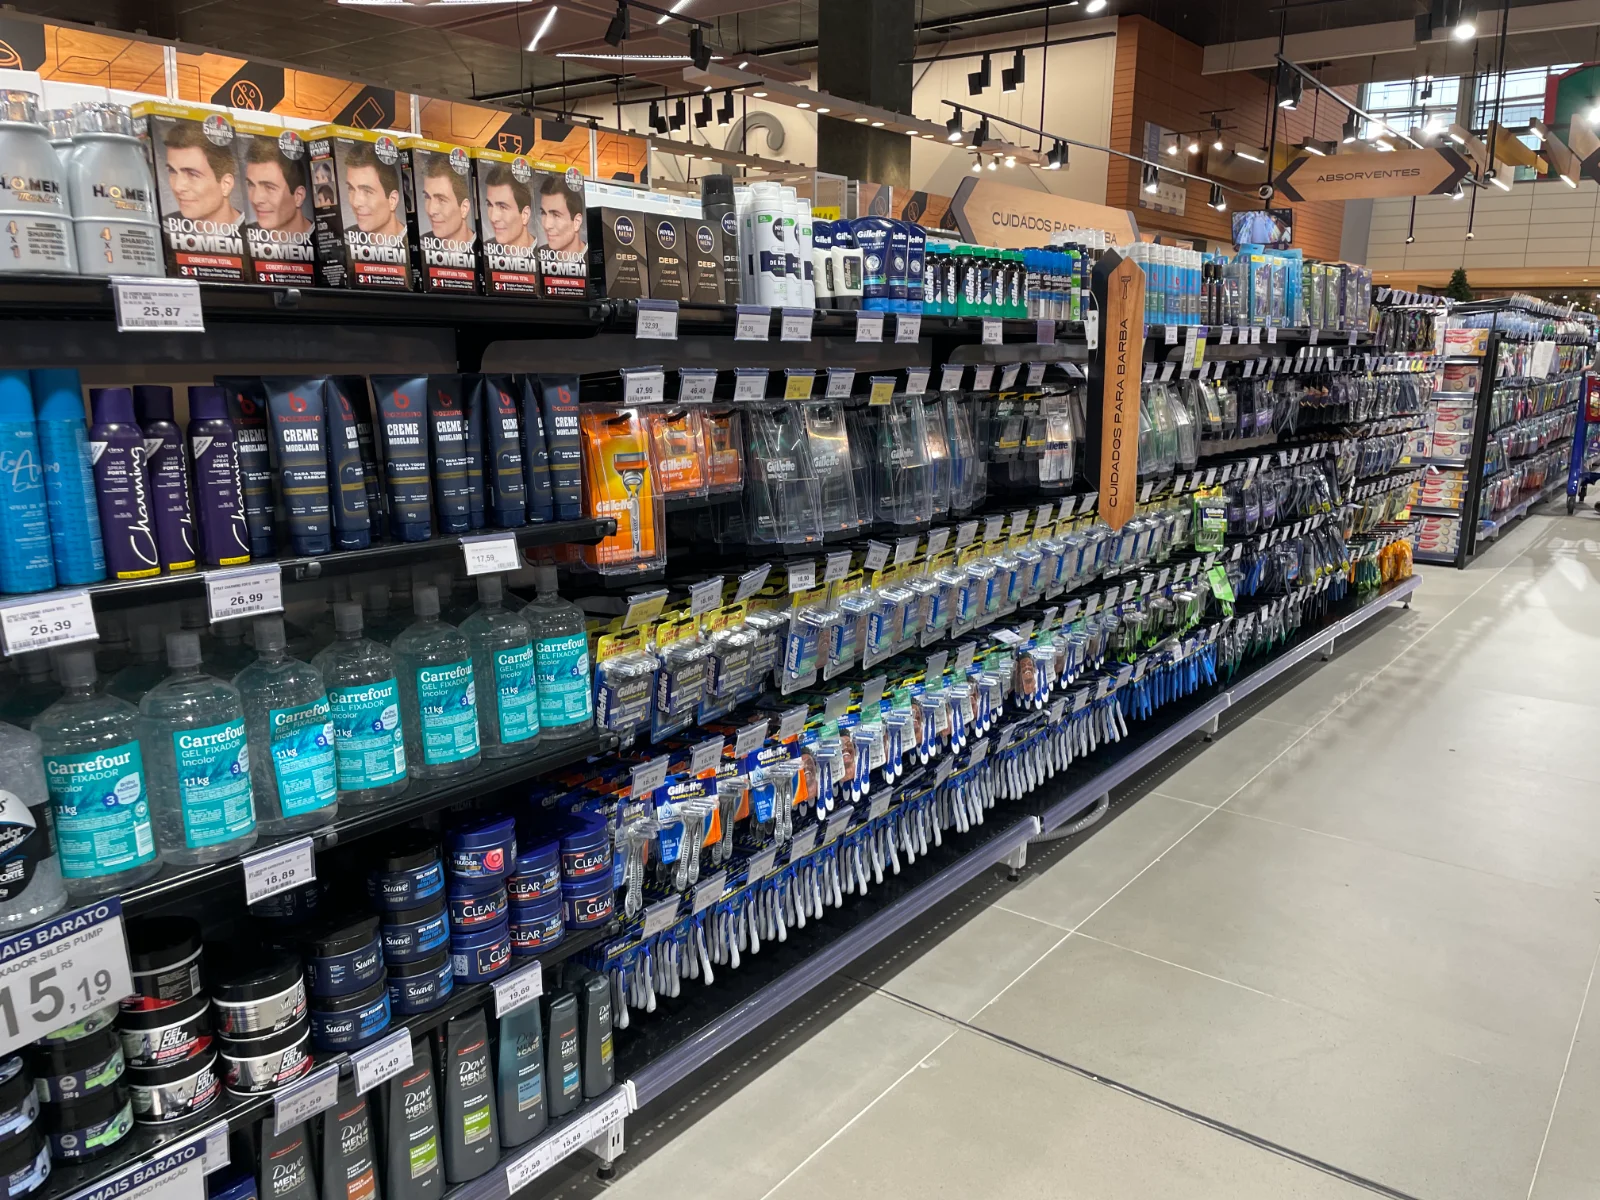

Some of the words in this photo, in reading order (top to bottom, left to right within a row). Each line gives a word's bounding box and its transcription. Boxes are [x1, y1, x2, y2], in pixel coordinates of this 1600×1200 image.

[203, 124, 210, 134] 5
[209, 128, 234, 139] MINUTOS
[1316, 166, 1421, 183] ABSORVENTES
[168, 218, 242, 238] BIOCOLOR
[616, 224, 633, 232] NIVEA
[992, 211, 1052, 232] CUIDADOS
[170, 233, 244, 255] HOMEM
[247, 228, 312, 246] BIOCOLOR
[348, 230, 405, 248] BIOCOLOR
[424, 236, 475, 254] BIOCOLOR
[250, 242, 315, 262] HOMEM
[350, 244, 407, 263] HOMEM
[487, 242, 536, 259] BIOCOLOR
[540, 249, 585, 263] BIOCOLOR
[616, 253, 638, 261] DEEP
[425, 250, 475, 269] HOMEM
[488, 255, 537, 273] HOMEM
[658, 256, 679, 264] DEEP
[697, 260, 716, 268] DEEP
[541, 261, 586, 277] HOMEM
[924, 265, 934, 304] Gillette
[947, 266, 955, 304] Gillette
[965, 266, 975, 304] Gillette
[143, 306, 181, 317] 25,87
[1117, 318, 1129, 375] BARBA
[1115, 379, 1125, 424] PARA
[386, 422, 419, 436] CREME
[436, 419, 462, 433] CREME
[555, 416, 578, 428] CREME
[283, 428, 319, 442] CREME
[285, 443, 320, 453] MODELADOR
[1109, 428, 1122, 508] CUIDADOS
[230, 592, 263, 606] 26,99
[30, 620, 72, 636] 26,39
[868, 614, 879, 646] Gillette
[535, 637, 585, 653] Carrefour
[788, 636, 800, 670] Gillette
[420, 664, 473, 683] Carrefour
[500, 665, 514, 673] GEL
[676, 663, 704, 682] Gillette
[421, 683, 438, 691] GEL
[440, 677, 469, 689] FIXADOR
[616, 681, 648, 697] Gillette
[329, 686, 393, 704] Carrefour
[422, 689, 449, 698] Incolor
[461, 696, 468, 706] 3
[275, 702, 331, 726] Carrefou
[330, 704, 346, 712] GEL
[348, 700, 385, 711] FIXADOR
[374, 721, 382, 731] 3
[179, 723, 245, 749] Carrefour
[274, 729, 301, 741] Incolor
[317, 736, 326, 746] 3
[205, 740, 240, 756] FIXADOR
[756, 746, 788, 761] Gillette
[47, 752, 131, 775] Carrefour
[182, 756, 216, 767] Incolor
[233, 763, 240, 774] 3
[71, 768, 119, 784] FIXADOR
[197, 776, 210, 787] kg
[667, 781, 703, 796] Gillette
[105, 795, 116, 806] 3
[574, 856, 603, 869] CLEAR
[264, 869, 295, 886] 18,89
[382, 881, 409, 894] Suave
[507, 882, 540, 894] CLEAR
[462, 901, 496, 918] CLEAR
[586, 900, 612, 914] CLEAR
[0, 937, 33, 960] AIS
[36, 905, 110, 944] BARATO
[385, 935, 411, 946] Suave
[509, 930, 540, 941] CLEAR
[40, 941, 71, 961] SILES
[73, 927, 104, 946] PUMP
[60, 959, 74, 971] R$
[355, 954, 376, 970] Suave
[408, 983, 434, 997] Suave
[82, 996, 106, 1011] CADA
[164, 1025, 182, 1040] GEL
[325, 1022, 353, 1033] Suave
[161, 1031, 188, 1048] COLA
[283, 1046, 298, 1061] GEL
[516, 1042, 540, 1057] +CARE
[280, 1051, 302, 1069] COLA
[374, 1057, 399, 1075] 14,49
[459, 1055, 486, 1075] Dove
[195, 1073, 216, 1093] COLA
[460, 1070, 480, 1083] MEN
[404, 1085, 432, 1107] Dove
[405, 1101, 426, 1115] MEN
[340, 1116, 368, 1141] Dove
[342, 1132, 363, 1148] MEN
[87, 1175, 130, 1200] MAIS
[133, 1146, 197, 1185] BARATO
[272, 1155, 304, 1180] Dove
[155, 1166, 188, 1192] FIXAÇÃO
[273, 1172, 298, 1189] MEN
